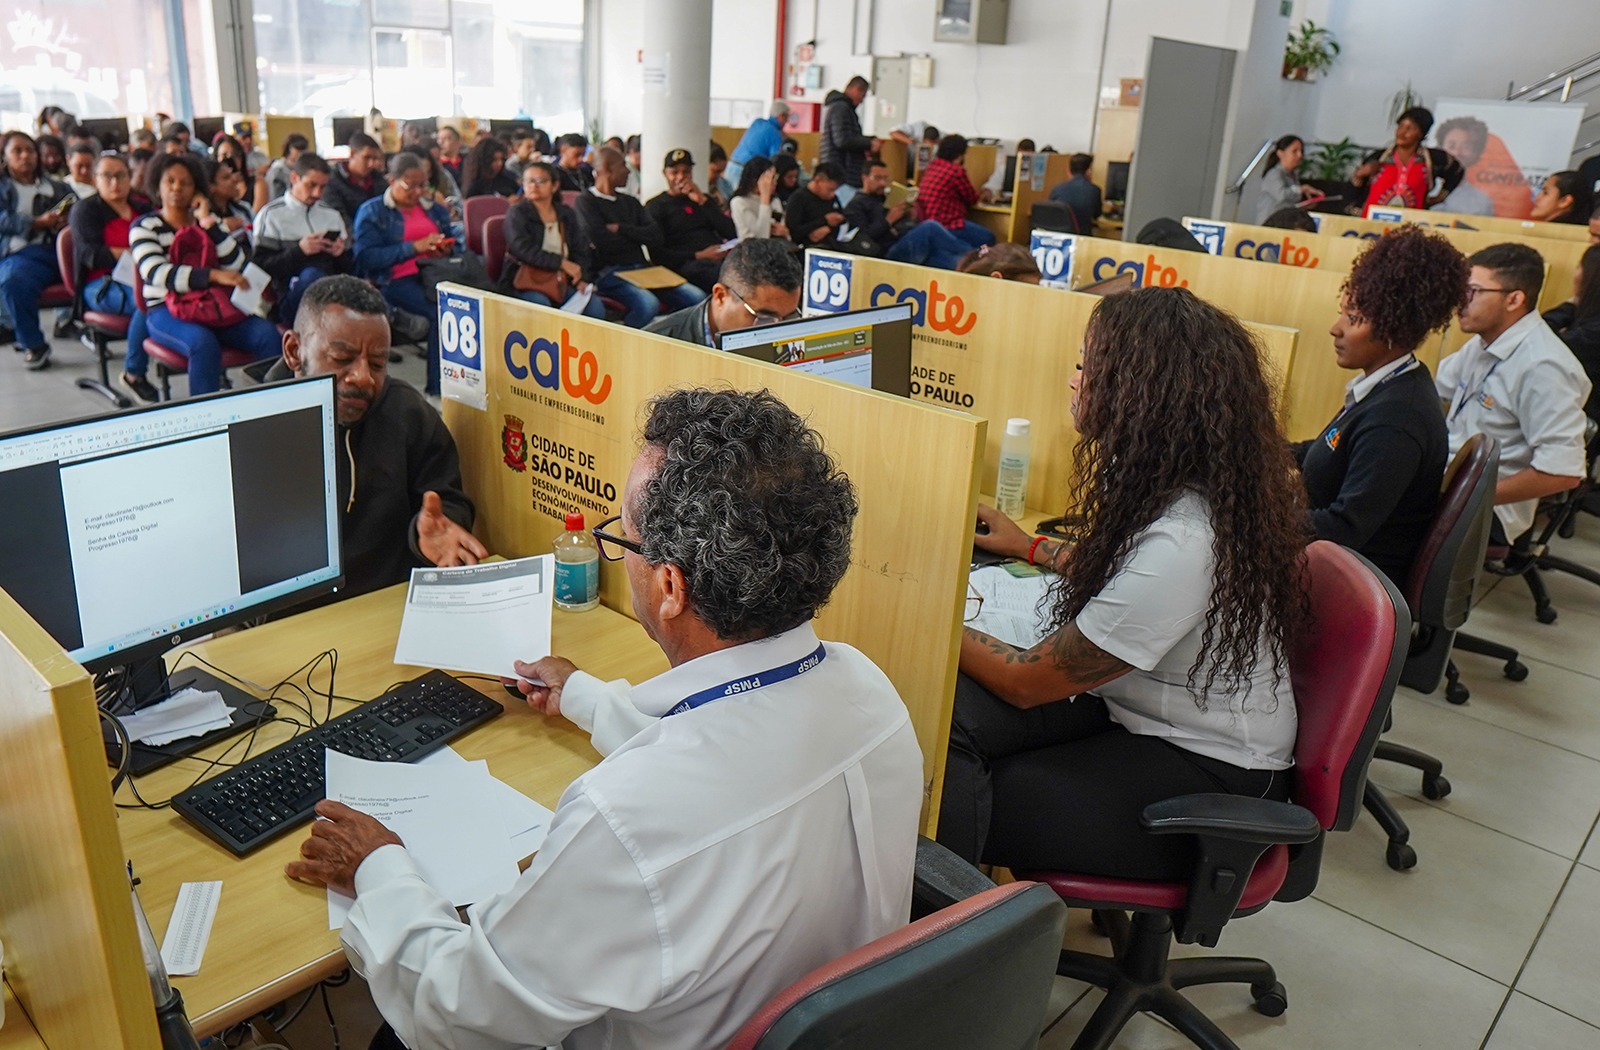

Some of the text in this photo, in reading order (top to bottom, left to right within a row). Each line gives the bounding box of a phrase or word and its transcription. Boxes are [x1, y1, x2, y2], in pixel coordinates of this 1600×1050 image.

[1032, 246, 1064, 276] 10
[1235, 236, 1319, 268] cate
[810, 270, 849, 306] 09
[870, 280, 977, 336] cate
[441, 310, 478, 358] 08
[504, 328, 612, 405] cate
[911, 366, 956, 386] ADE DE
[510, 385, 605, 425] TRABALHO E EMPREENDEDORISMO
[924, 384, 974, 408] PAULO
[532, 434, 595, 471] CIDADE DE
[532, 453, 616, 502] SÃO PAULO
[532, 476, 609, 515] DESENVOLVIMENTO
[532, 488, 580, 513] ECONÔMICO
[532, 500, 566, 523] E TRABAL
[797, 654, 819, 673] PMSP
[724, 677, 761, 696] PMSP
